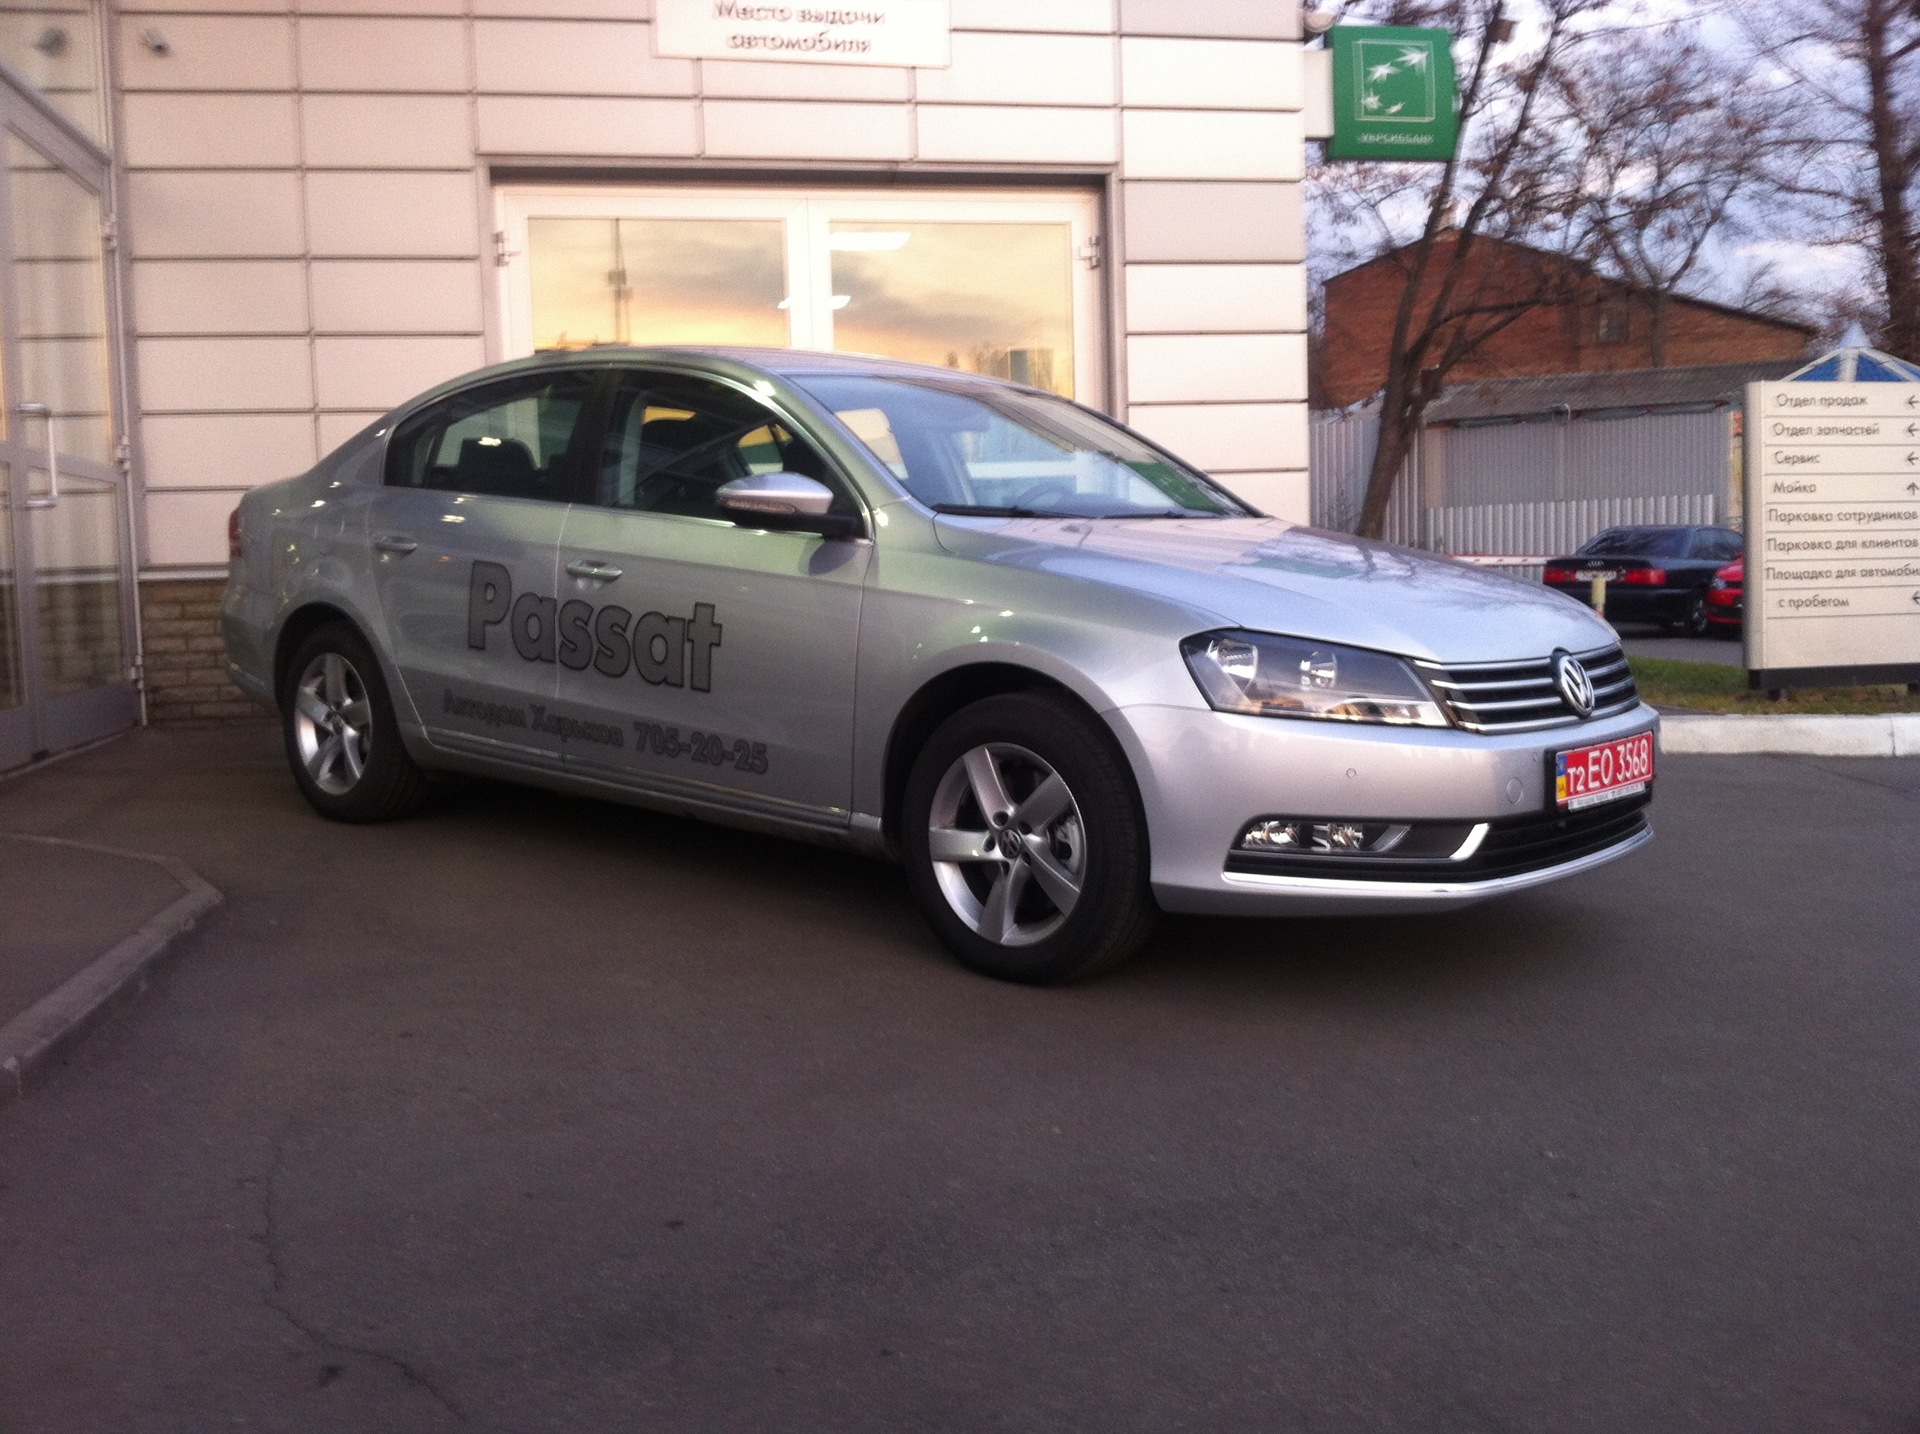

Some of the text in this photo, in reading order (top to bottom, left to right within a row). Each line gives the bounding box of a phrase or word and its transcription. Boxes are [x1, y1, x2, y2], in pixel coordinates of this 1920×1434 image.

[714, 0, 885, 24] Место выдачи
[727, 30, 872, 52] автомобиля
[1776, 393, 1868, 407] Отдел продаж
[1773, 422, 1880, 436] Отдел запчастей
[1774, 451, 1821, 465] Сервис
[1773, 481, 1817, 494] Мойка
[1768, 508, 1918, 524] Парковка сотрудников
[1767, 538, 1919, 554] Парковка для клиентов
[1766, 567, 1832, 582] Площадка
[1835, 569, 1857, 580] для
[1778, 594, 1850, 610] с пробегом
[468, 559, 723, 693] Passat
[529, 705, 624, 748] Харьков
[633, 720, 769, 775] 705-20-25
[1616, 739, 1648, 782] 3568
